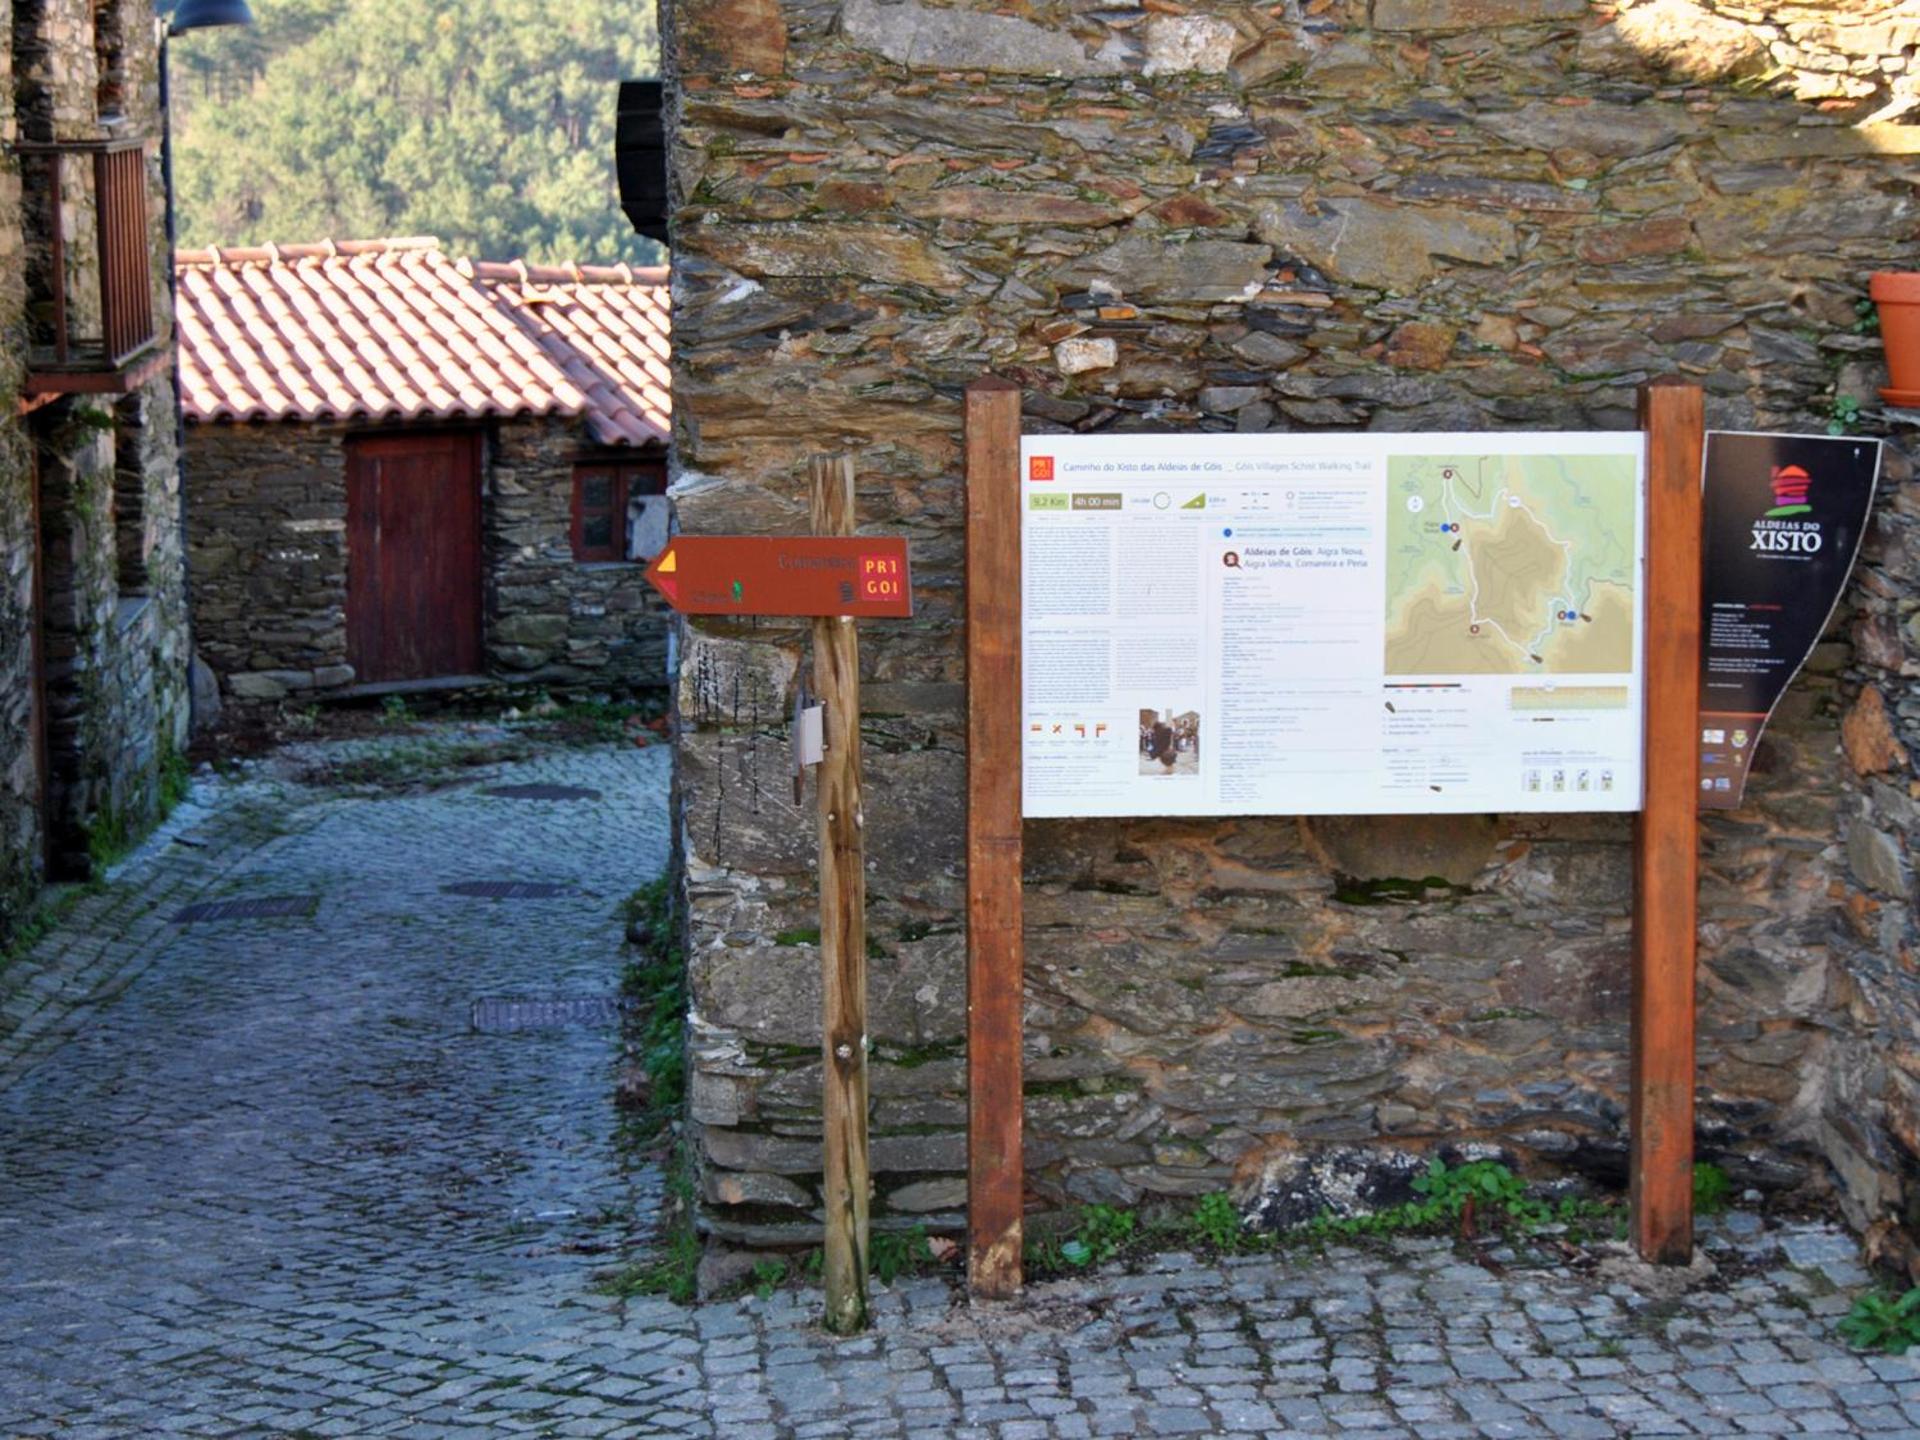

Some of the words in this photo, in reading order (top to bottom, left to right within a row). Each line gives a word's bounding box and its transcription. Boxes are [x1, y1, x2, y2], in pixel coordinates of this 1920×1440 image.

[1063, 462, 1100, 472] Caminho
[1103, 462, 1114, 472] do
[1117, 462, 1139, 472] Xisto
[1141, 462, 1155, 472] das
[1157, 462, 1188, 472] Aldeias
[1190, 462, 1201, 472] de
[1753, 520, 1800, 530] ALDEIAS
[1803, 522, 1820, 531] DO
[1750, 530, 1822, 553] XISTO
[1244, 547, 1277, 556] Aldeias
[1279, 547, 1290, 556] de
